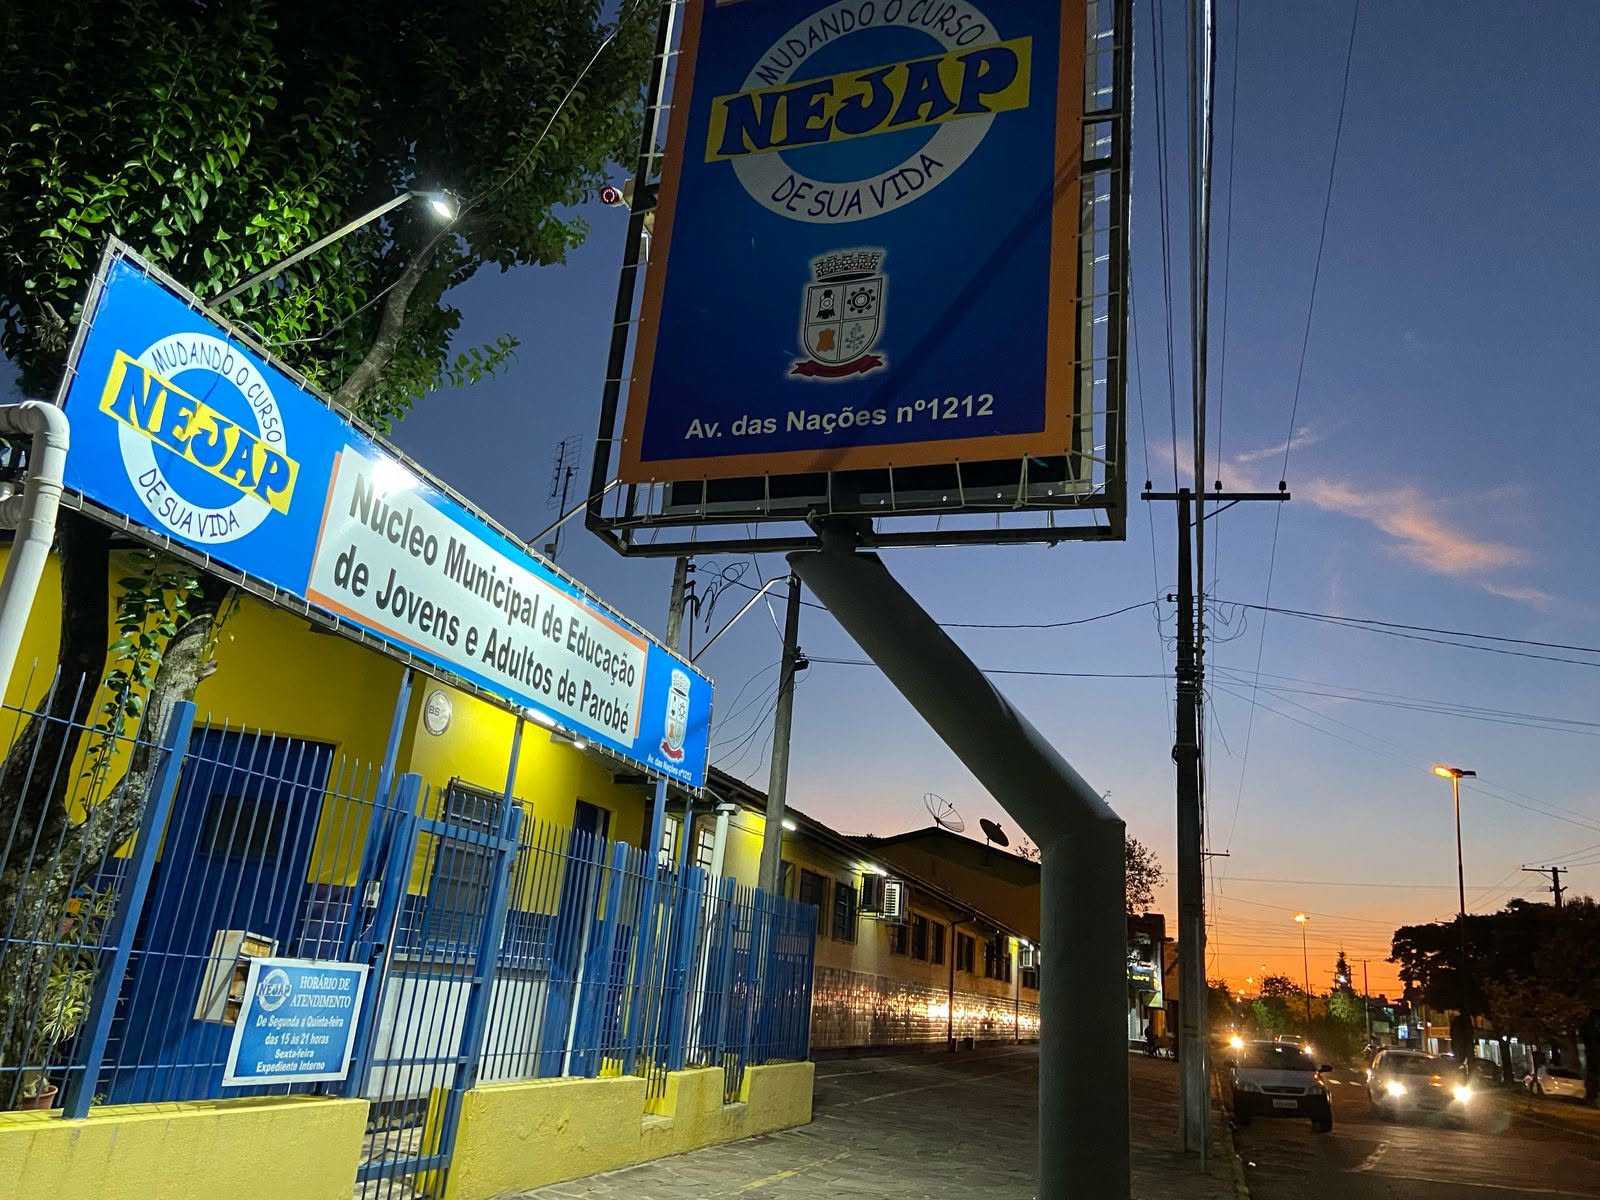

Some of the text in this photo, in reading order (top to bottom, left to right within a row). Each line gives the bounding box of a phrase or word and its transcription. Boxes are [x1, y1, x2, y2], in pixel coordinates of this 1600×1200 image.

[756, 0, 985, 86] MUDANDO O CURSO
[717, 47, 1018, 157] NEJAP
[771, 153, 943, 218] DE SUA VIDA
[151, 340, 283, 443] MUDANDO O CURSO
[685, 393, 994, 440] Av. das Nações nº1212
[109, 361, 292, 506] NEJAP
[139, 468, 240, 537] DE SUA VIDA
[349, 473, 635, 687] Núcleo Municipal de Educação
[334, 545, 629, 735] de Jovens e Adultos de Parobé
[655, 757, 663, 768] das
[290, 994, 350, 1008] ATENDIMENTO
[300, 974, 350, 990] HORÁRIO DE
[256, 1015, 267, 1027] De
[268, 1015, 300, 1030] Segunda
[306, 1015, 344, 1027] Quinta-feira
[264, 1032, 279, 1045] das
[281, 1033, 290, 1045] 15
[300, 1033, 310, 1045] 21
[310, 1033, 329, 1044] horas
[256, 1060, 326, 1074] Expediente Interno
[274, 1048, 315, 1059] Sexta-feira
